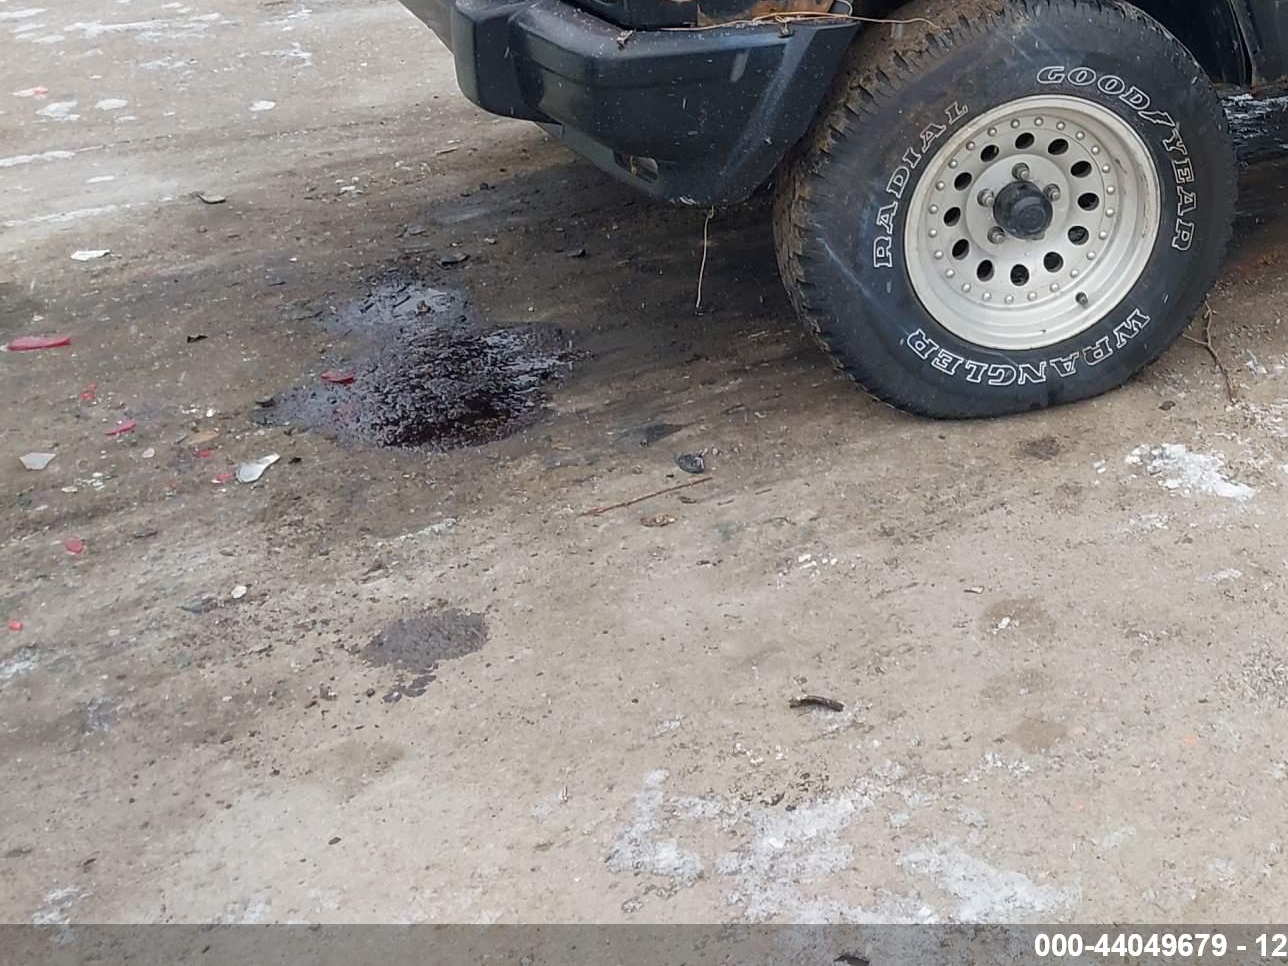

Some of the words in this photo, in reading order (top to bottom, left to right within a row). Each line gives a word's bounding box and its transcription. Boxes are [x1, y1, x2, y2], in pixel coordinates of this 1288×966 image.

[873, 100, 970, 268] RADIAL
[1036, 65, 1197, 251] GOODYEAR
[906, 308, 1151, 386] WRANGLER
